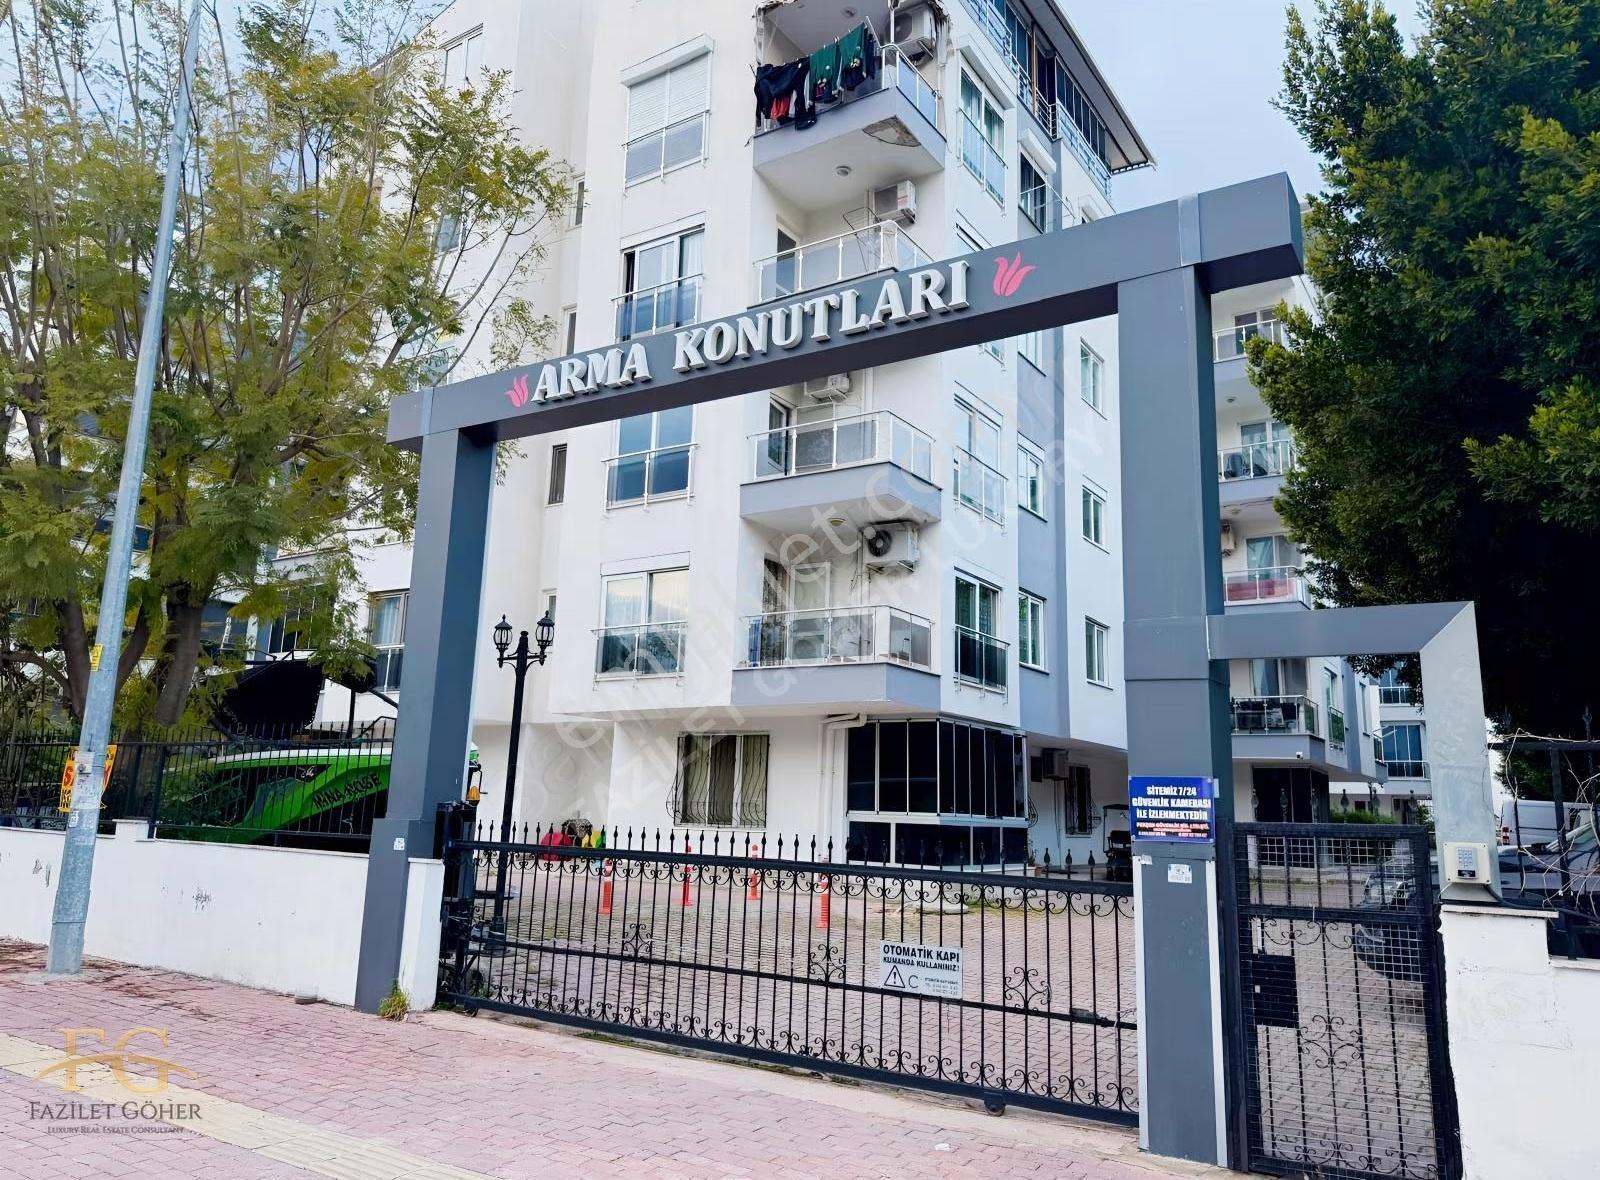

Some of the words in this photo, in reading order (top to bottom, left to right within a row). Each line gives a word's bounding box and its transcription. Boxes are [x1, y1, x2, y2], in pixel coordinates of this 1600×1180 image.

[530, 342, 653, 404] ARMA
[673, 259, 970, 373] KONUTLARI
[1146, 785, 1178, 796] SİTEMİZ
[1179, 786, 1198, 797] 7/24
[1132, 797, 1170, 807] GÜVENLİK
[1170, 798, 1211, 808] KAMERASI
[1136, 808, 1147, 819] İLE
[883, 944, 933, 959] OTOMATİK
[936, 950, 960, 962] KAPI
[883, 956, 915, 966] KUMANDA
